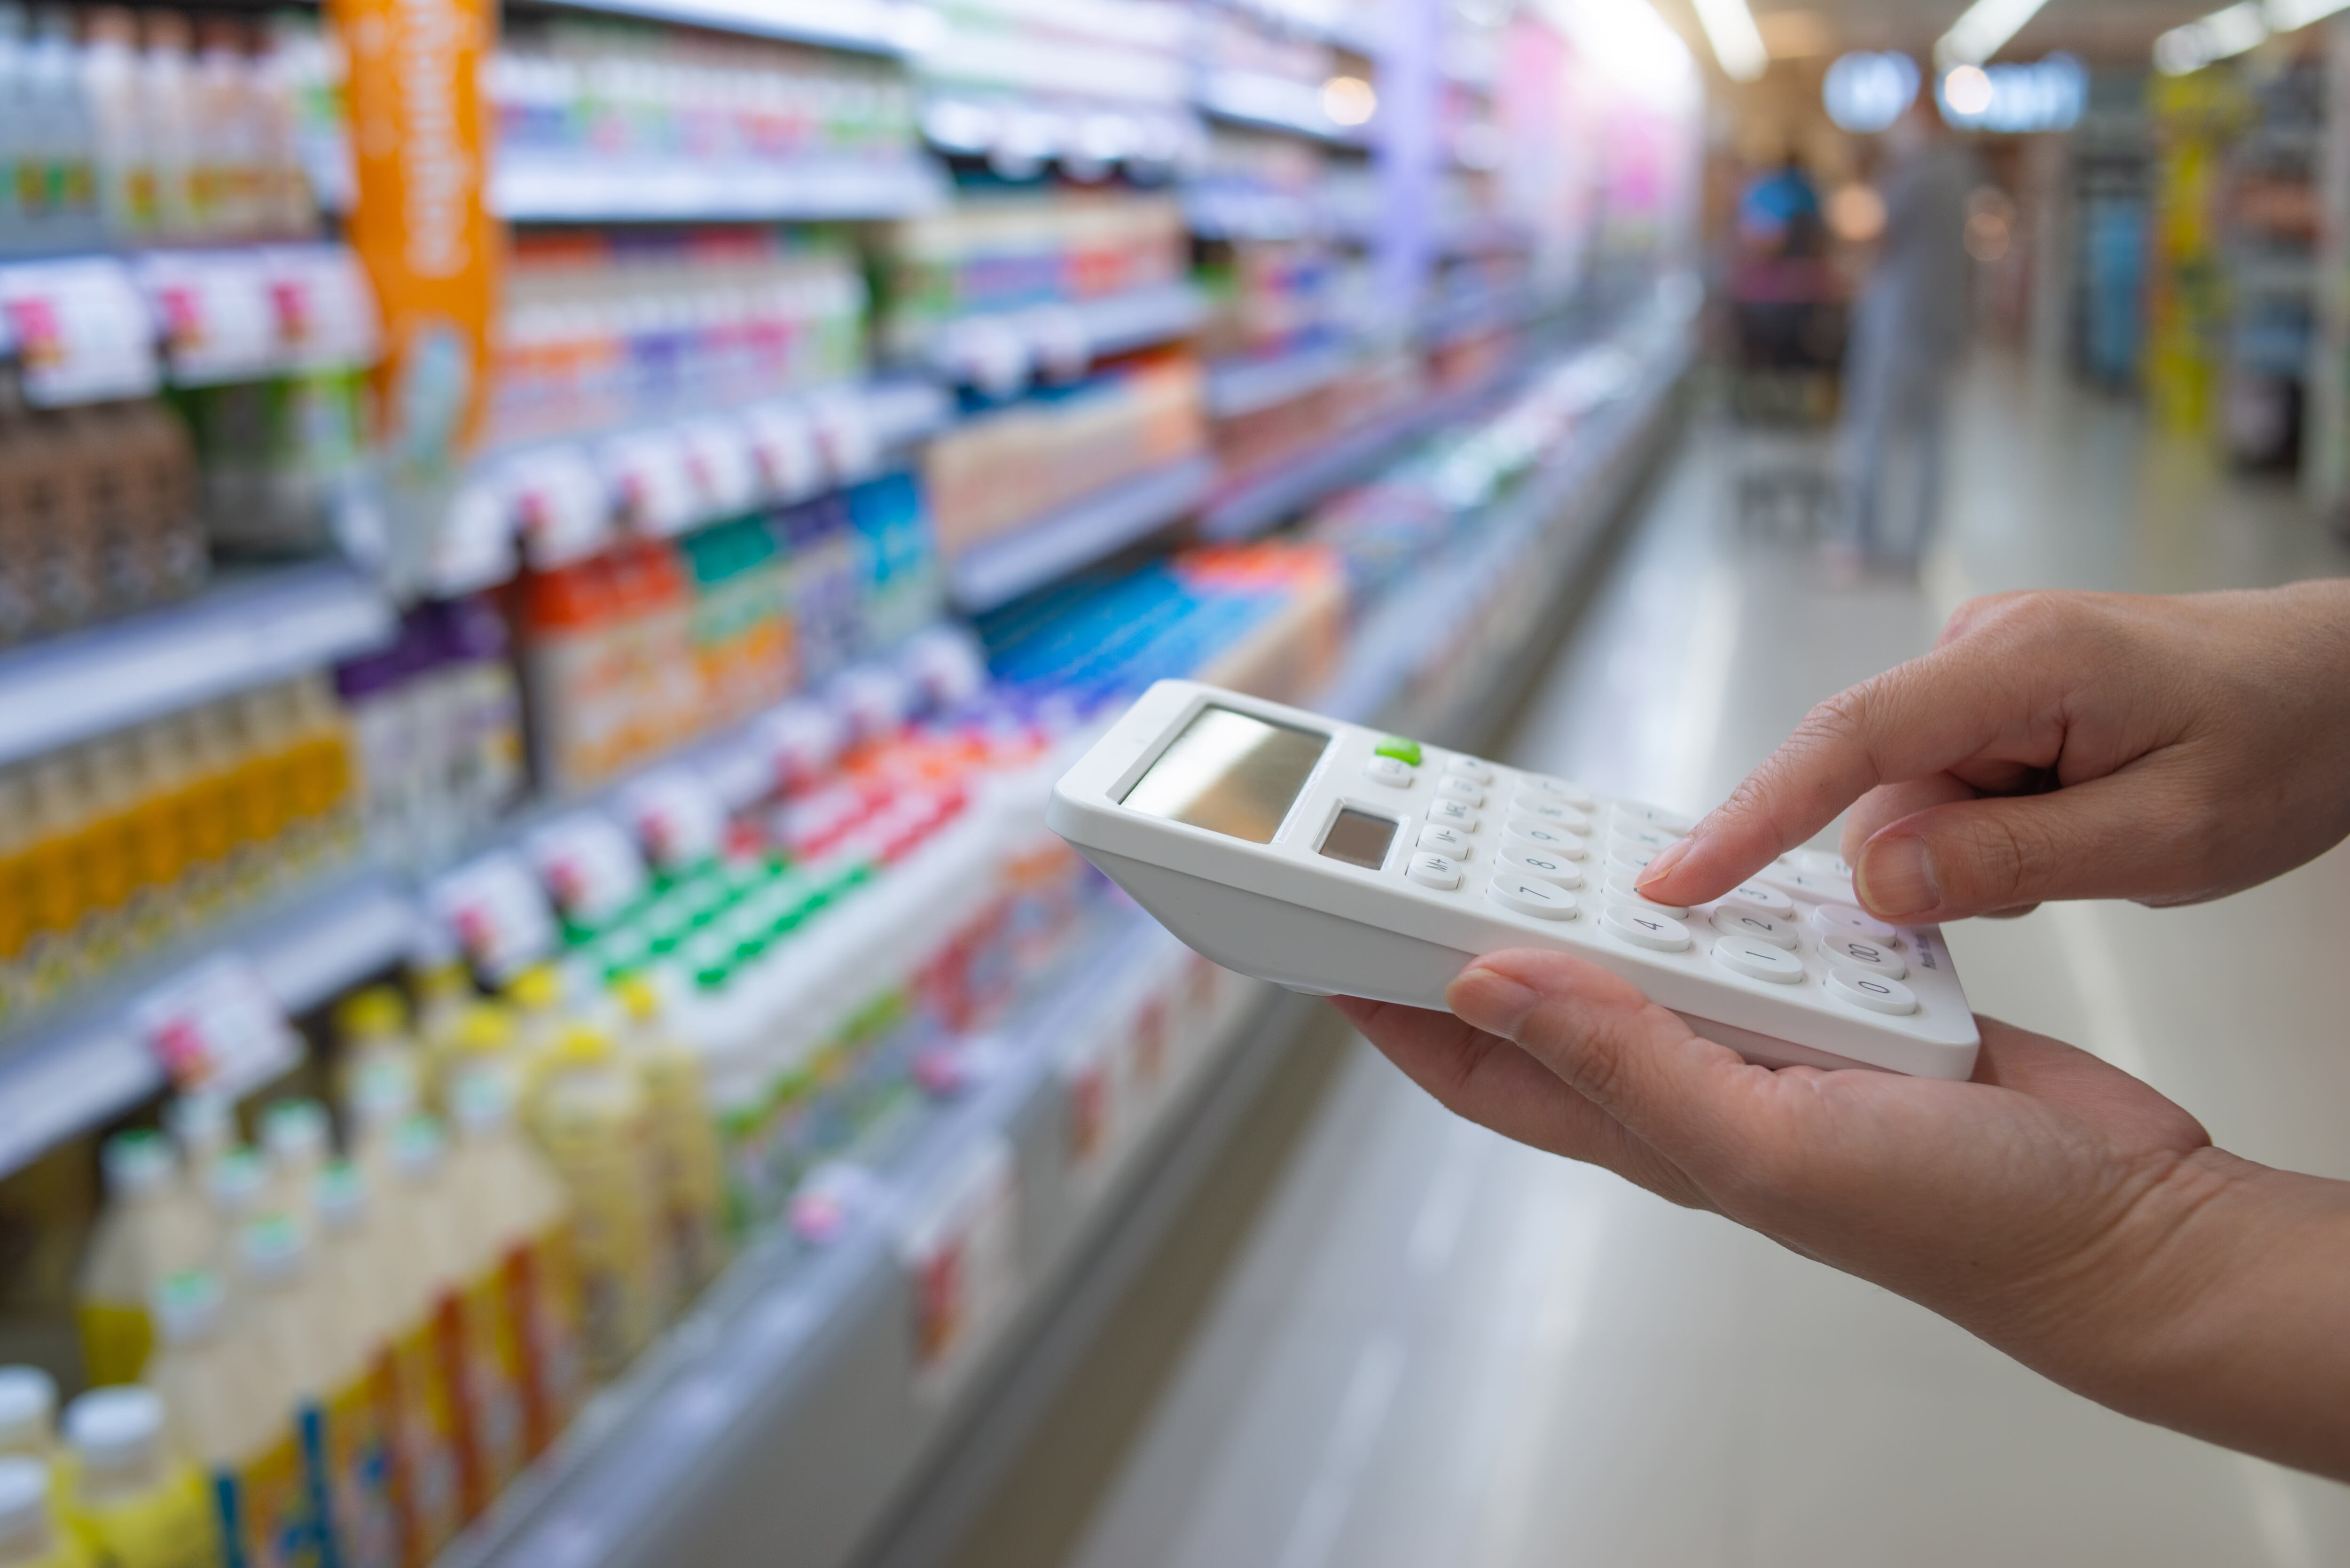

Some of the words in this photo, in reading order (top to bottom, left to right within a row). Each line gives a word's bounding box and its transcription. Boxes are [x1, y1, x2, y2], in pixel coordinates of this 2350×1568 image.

[1531, 831, 1559, 842] 9
[1426, 858, 1448, 873] M+
[1526, 859, 1556, 869] 8
[1520, 886, 1550, 899] 7
[1633, 918, 1664, 930] 4
[1741, 918, 1772, 931] 2
[1745, 951, 1777, 961] 1
[1848, 944, 1881, 962] 00
[1857, 981, 1890, 994] 0
